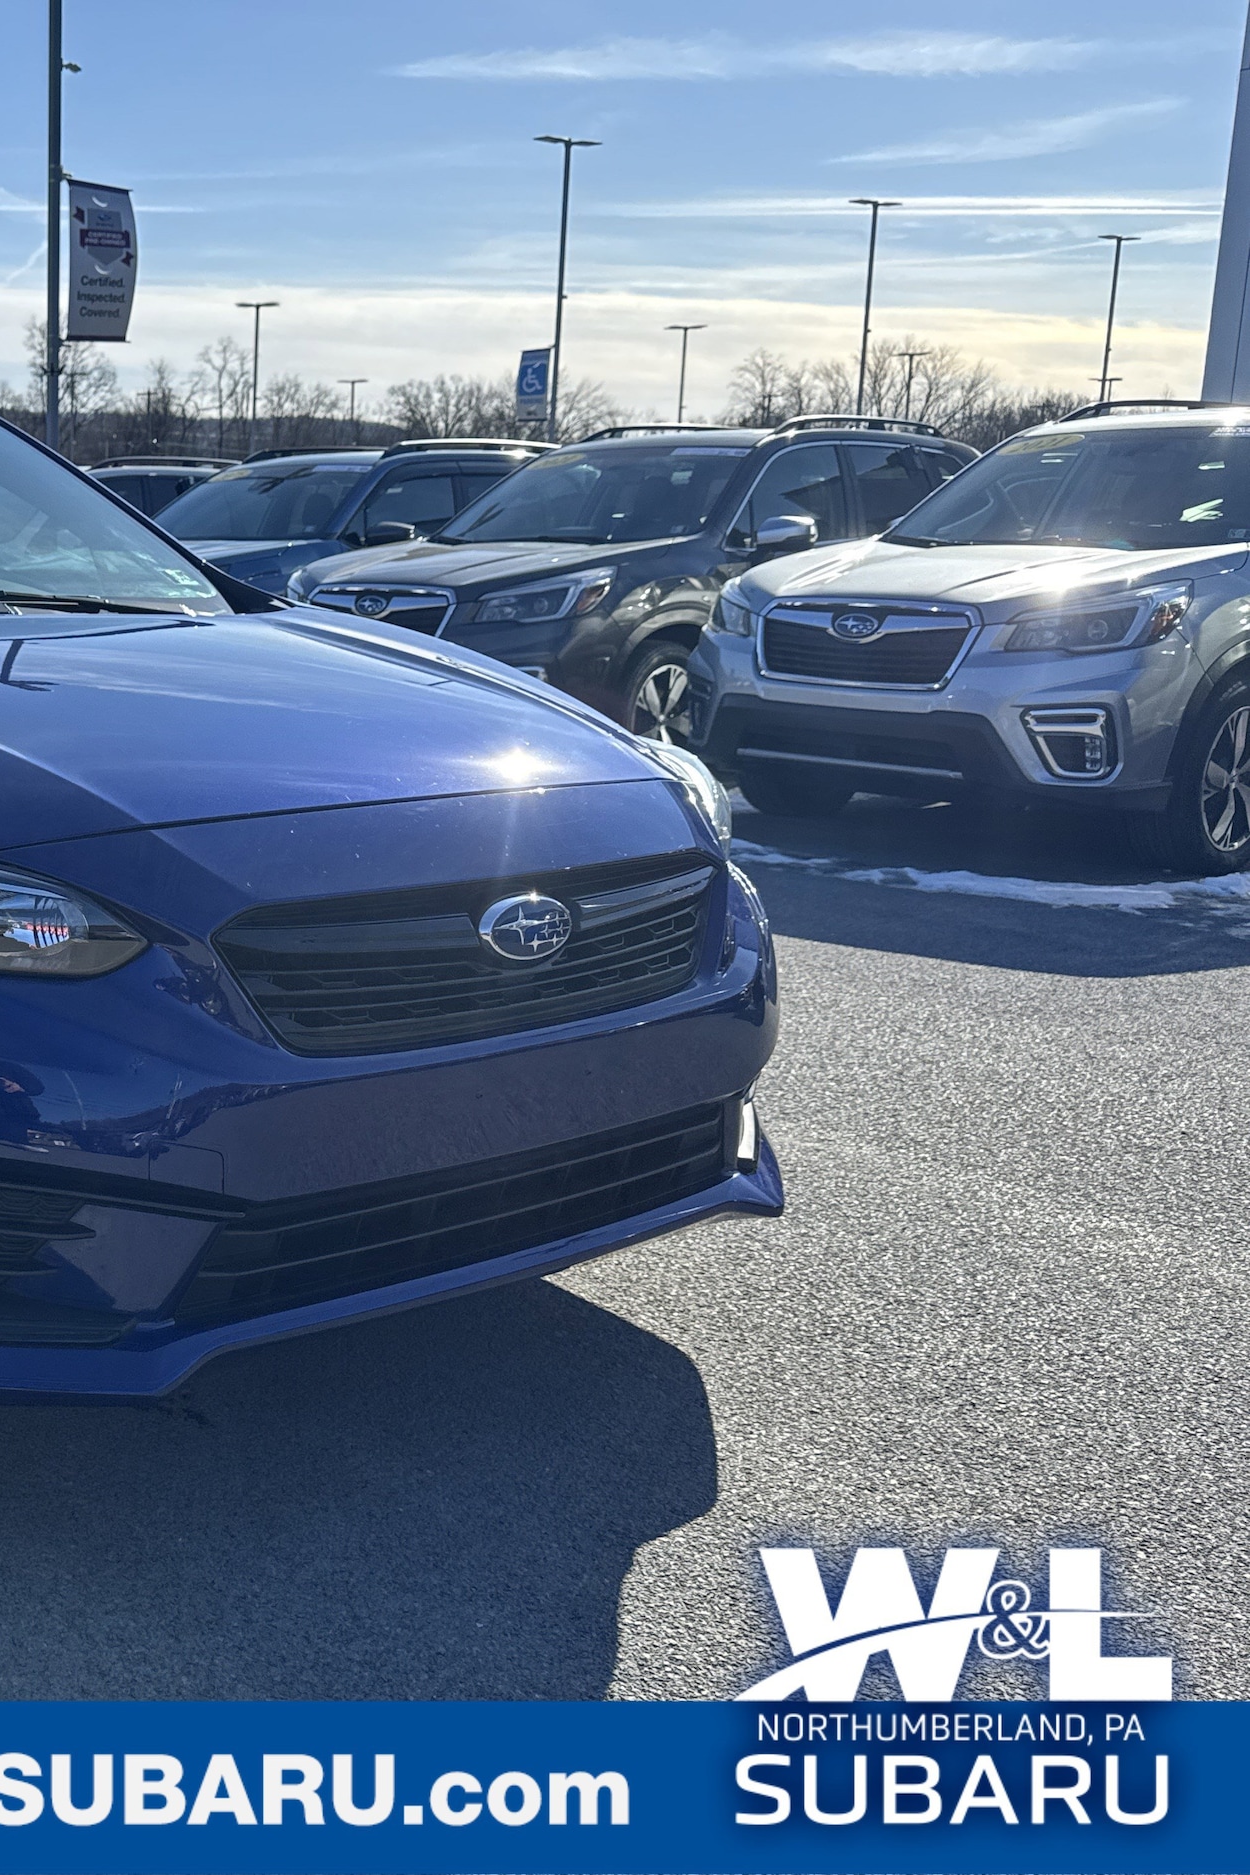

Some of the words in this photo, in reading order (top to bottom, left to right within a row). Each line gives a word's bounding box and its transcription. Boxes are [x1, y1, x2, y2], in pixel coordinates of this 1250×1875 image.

[80, 275, 125, 288] Certified.
[77, 291, 126, 304] Inspected.
[79, 306, 121, 318] Covered.
